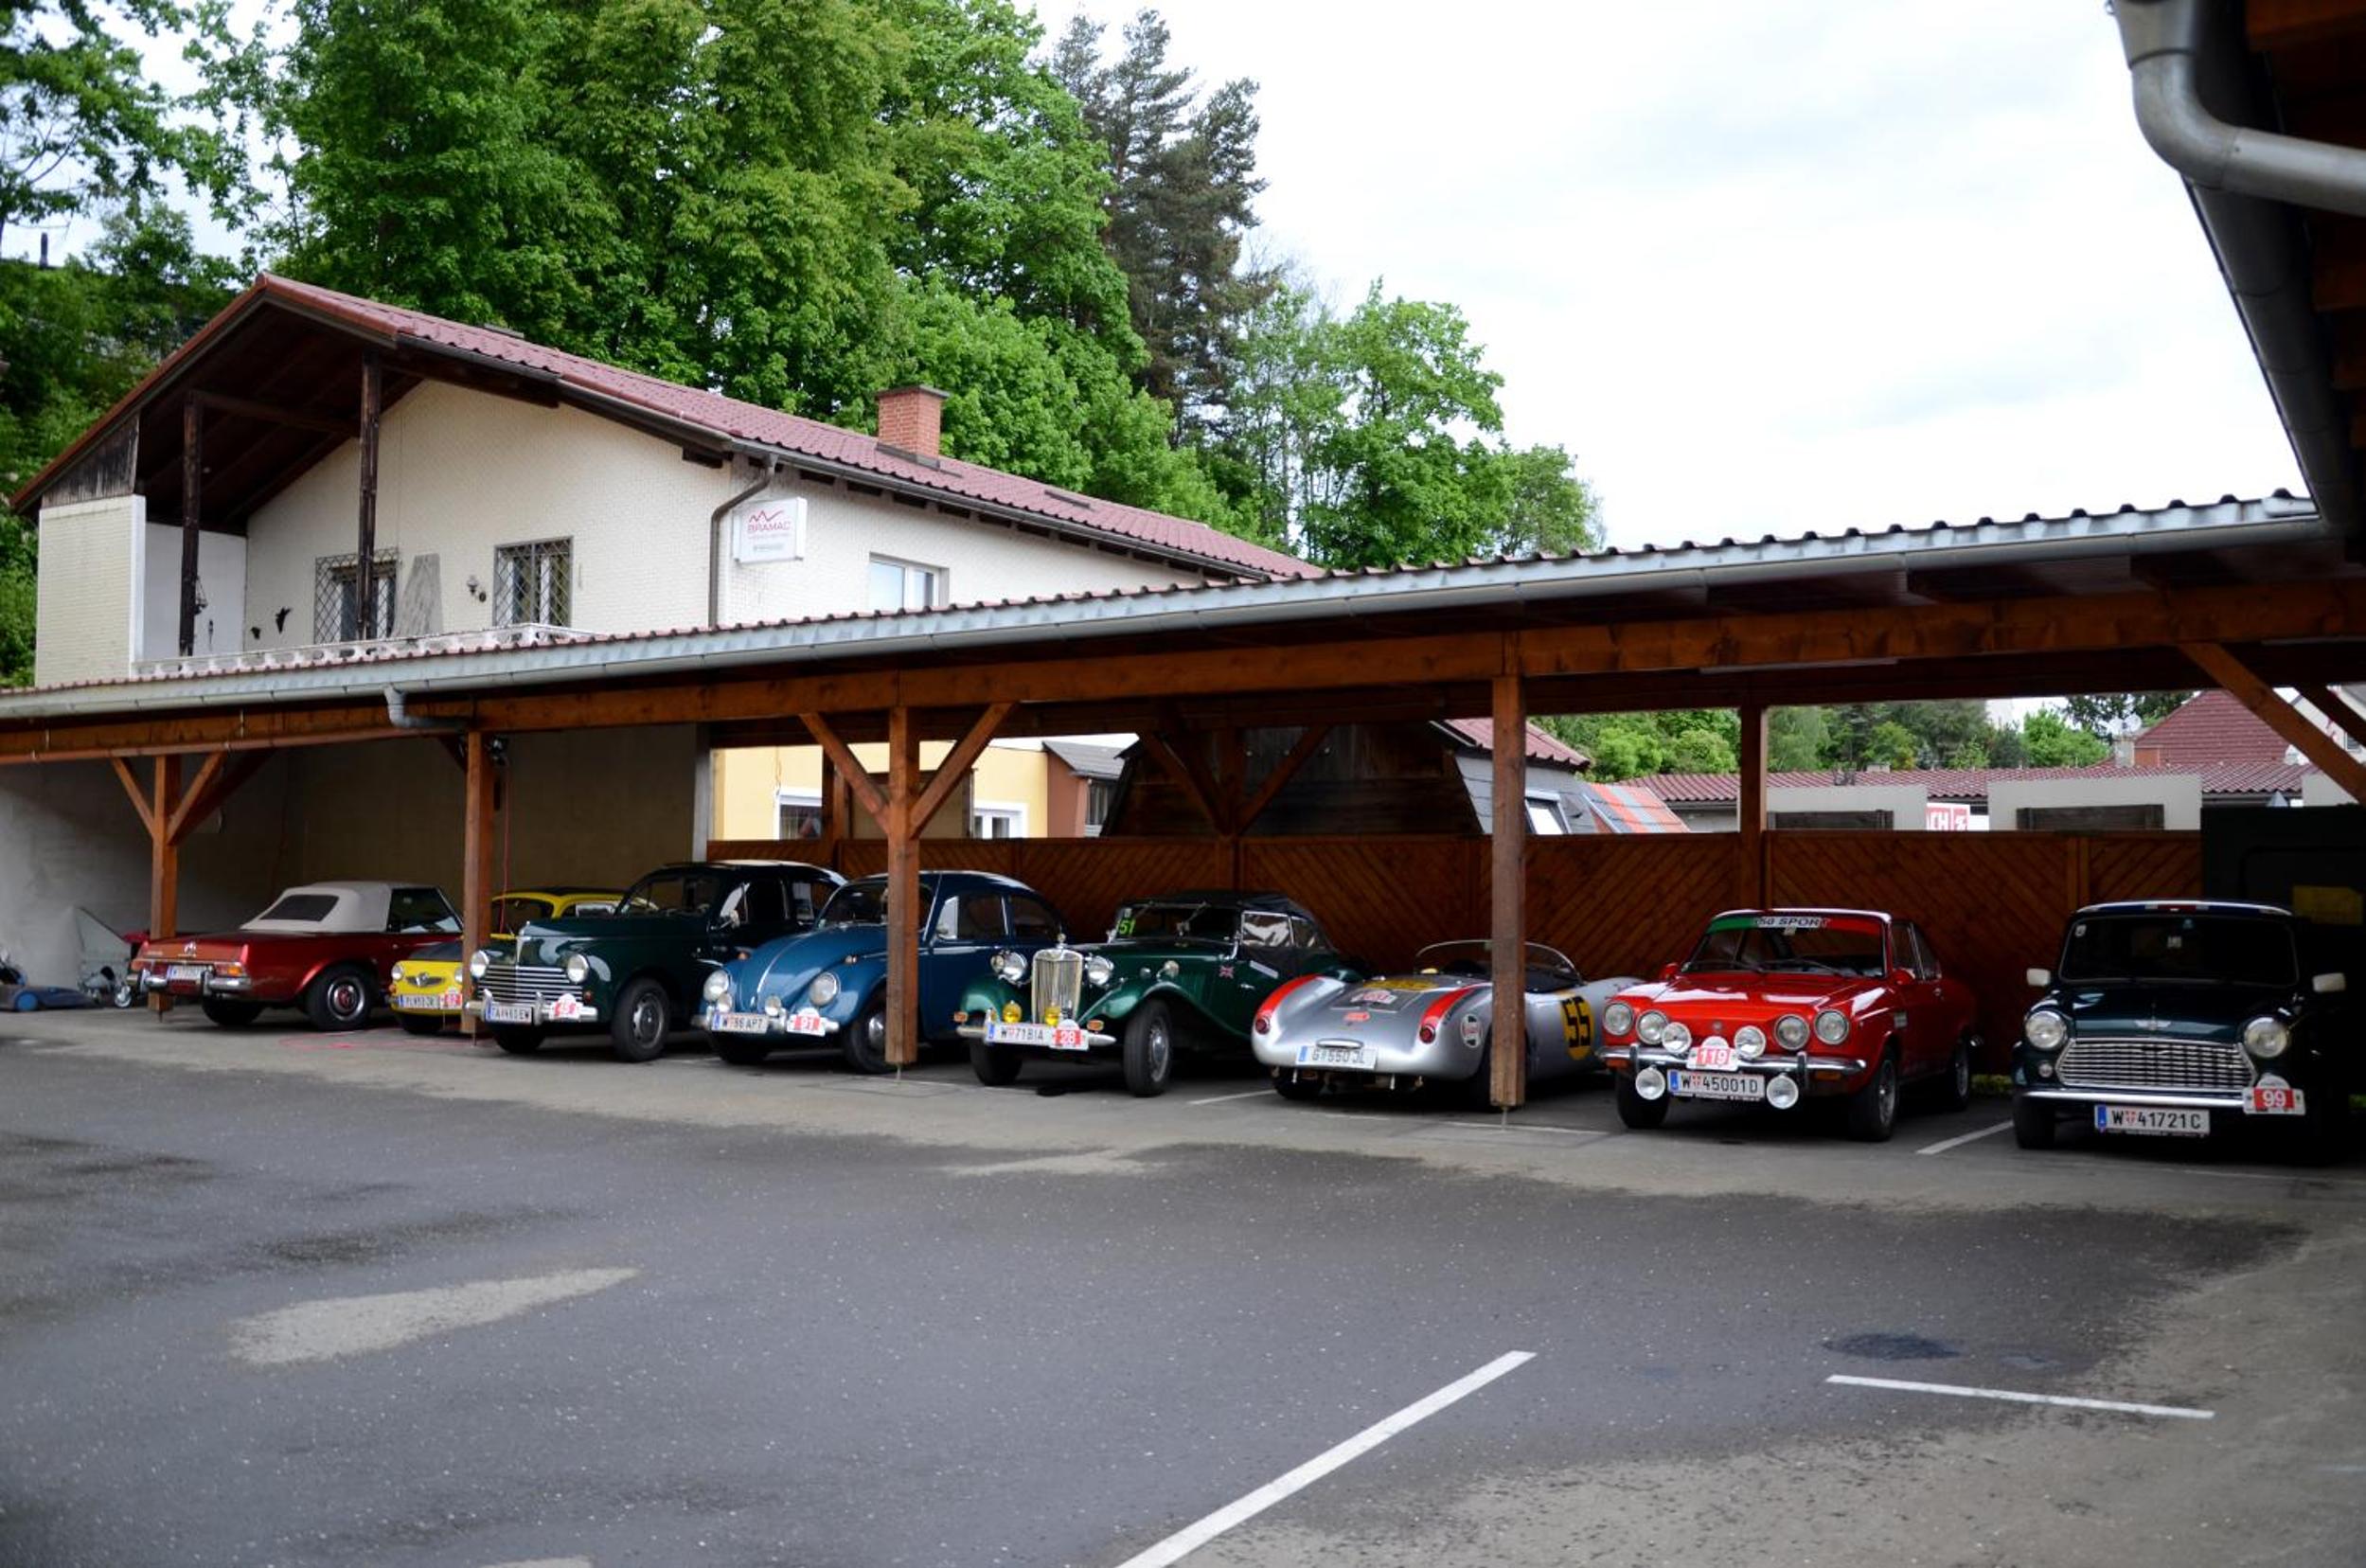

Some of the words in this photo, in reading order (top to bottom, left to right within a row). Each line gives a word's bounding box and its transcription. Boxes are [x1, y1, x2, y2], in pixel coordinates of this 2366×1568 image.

[1119, 918, 1136, 935] 51
[1560, 996, 1592, 1048] 55
[1061, 1031, 1076, 1044] 28
[1699, 1048, 1728, 1065] 119
[2262, 1090, 2286, 1107] 99
